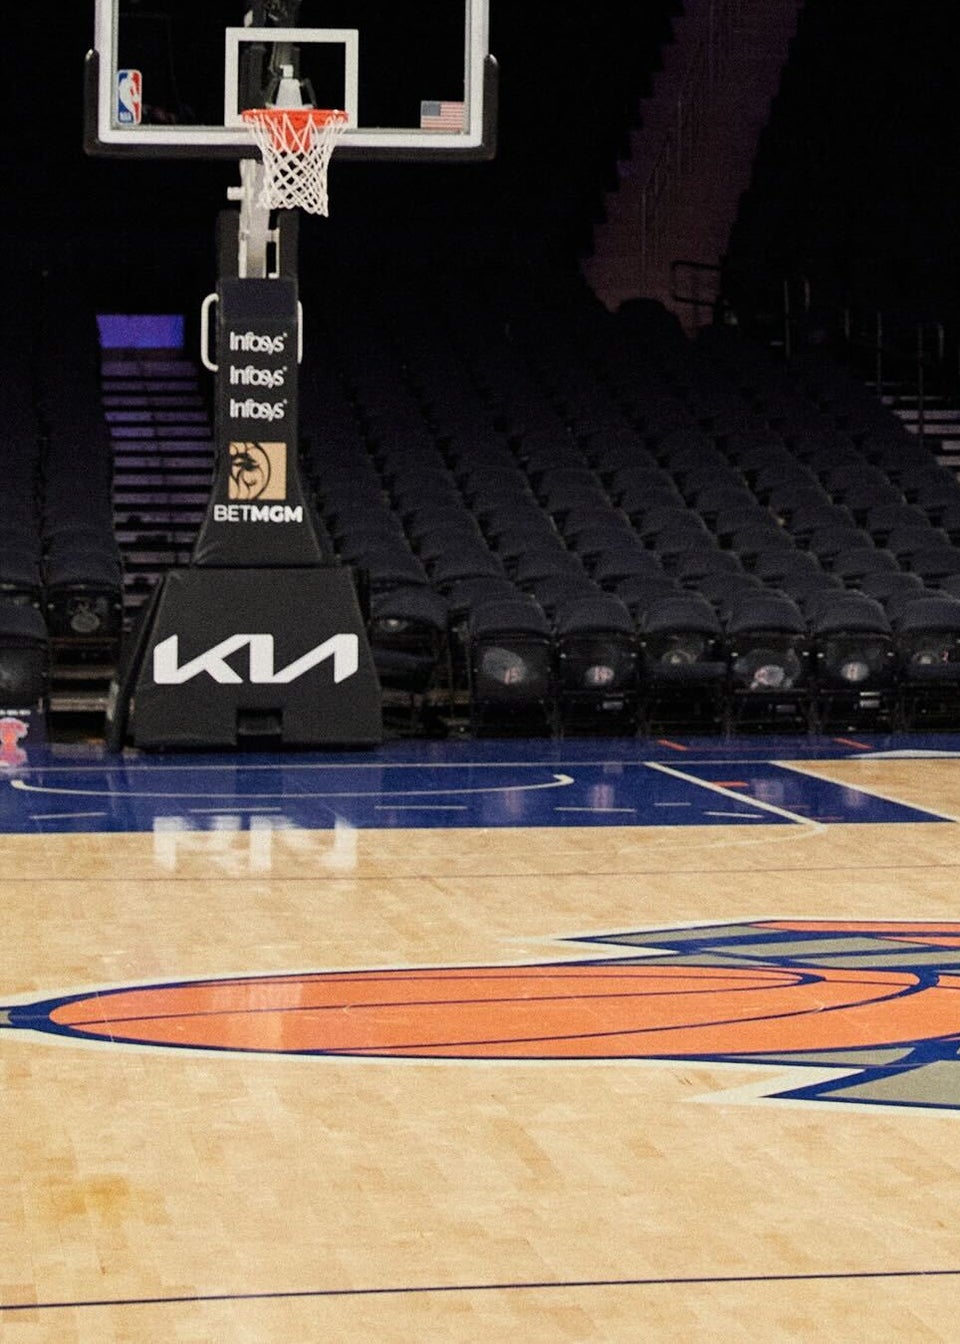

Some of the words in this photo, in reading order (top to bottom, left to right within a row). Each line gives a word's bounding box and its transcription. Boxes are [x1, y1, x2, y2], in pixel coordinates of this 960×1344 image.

[230, 331, 286, 355] Infosys
[230, 365, 286, 389] Infosys
[230, 398, 286, 422] Infosys
[213, 504, 303, 523] BETMGM
[153, 633, 359, 685] KIA
